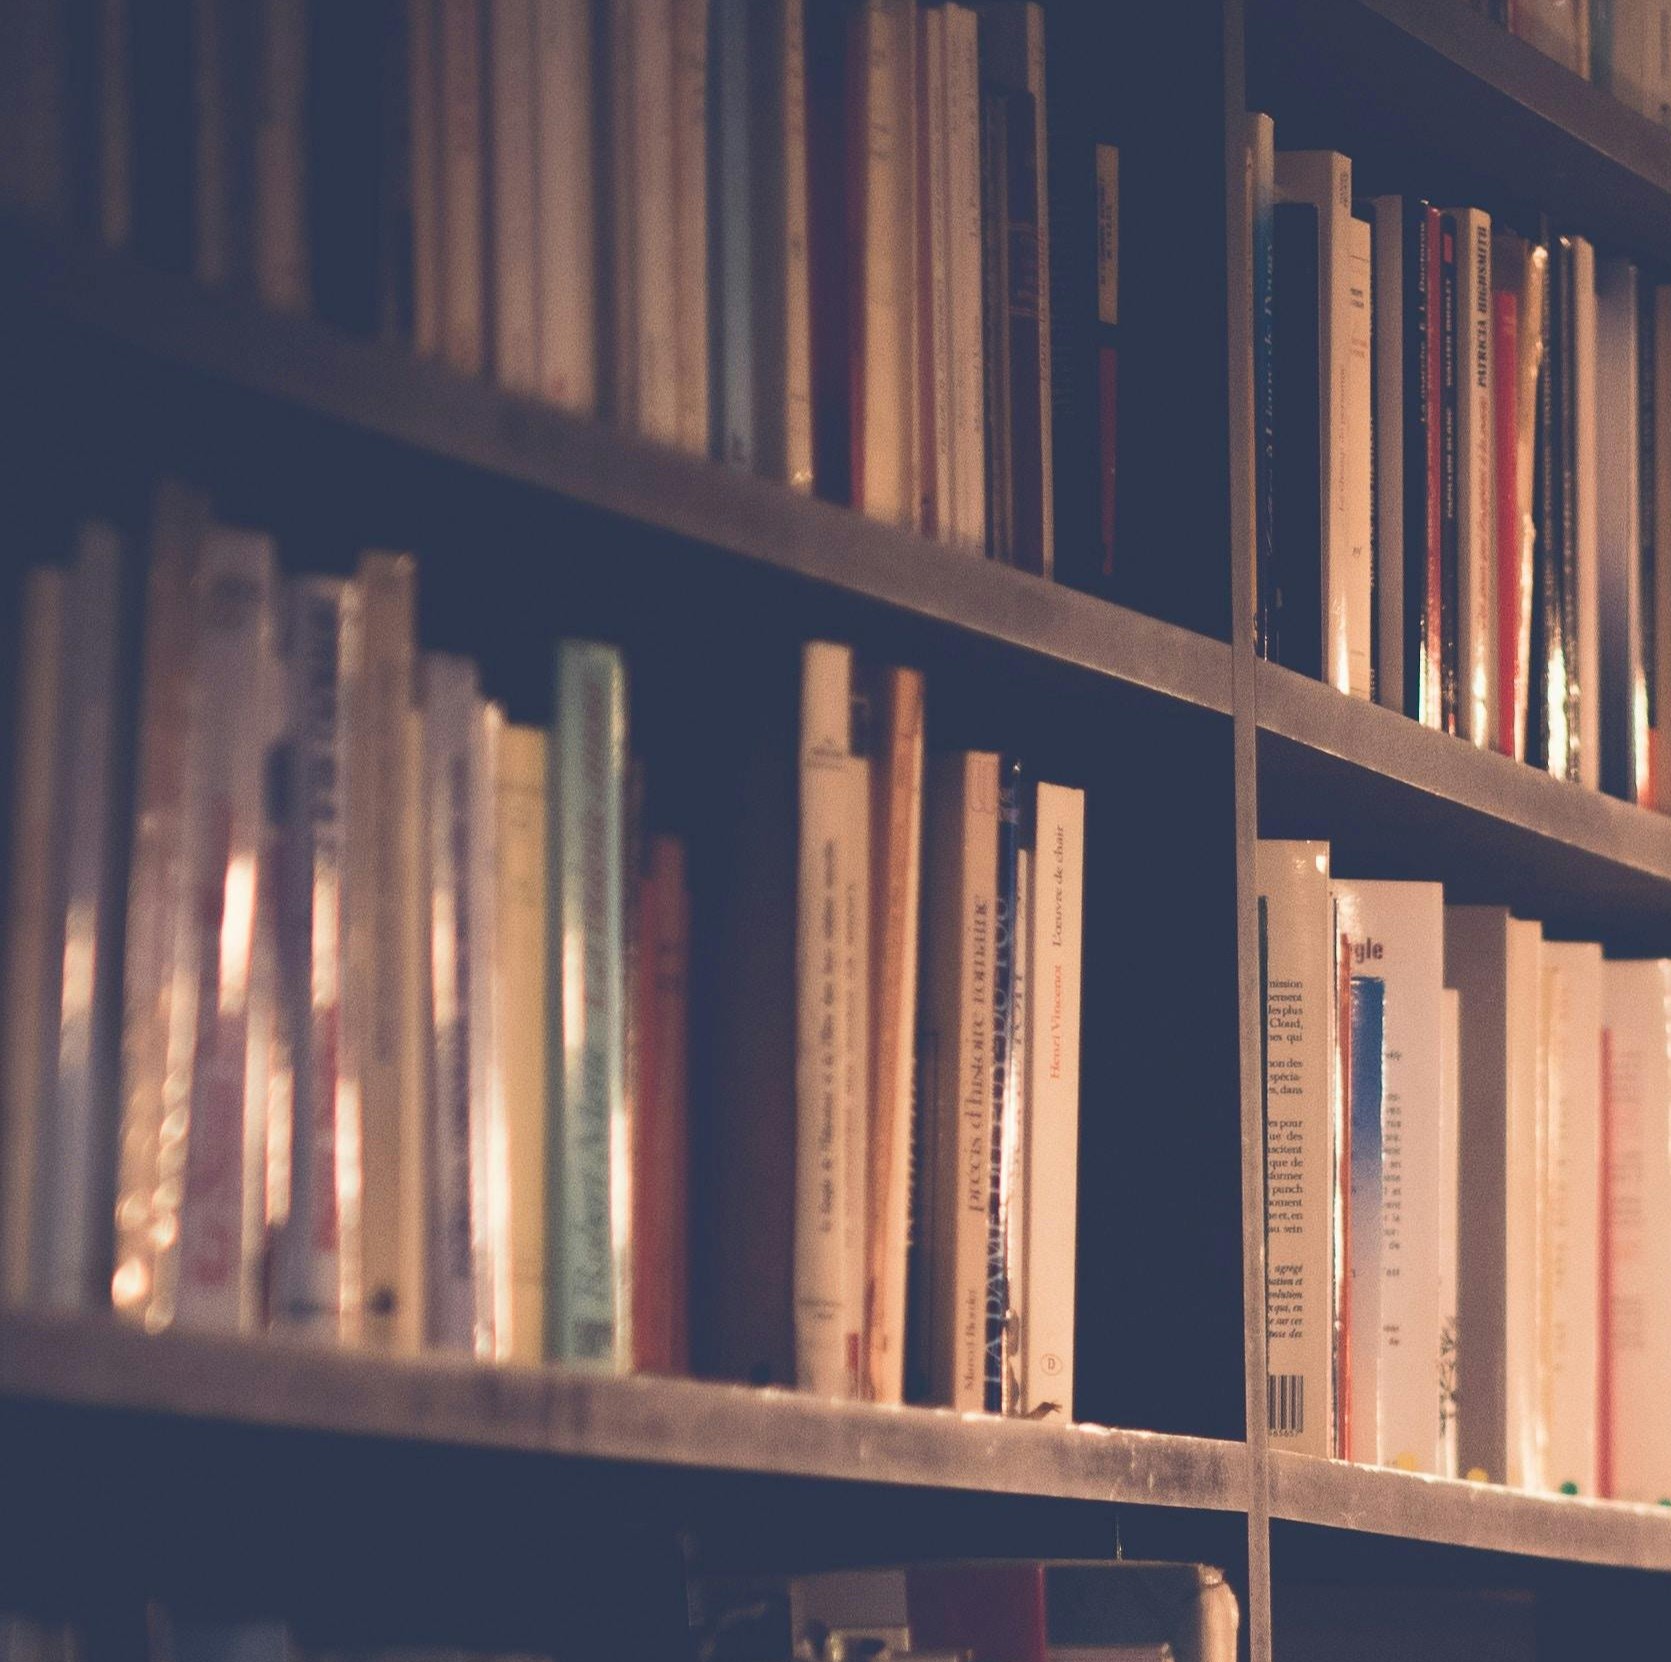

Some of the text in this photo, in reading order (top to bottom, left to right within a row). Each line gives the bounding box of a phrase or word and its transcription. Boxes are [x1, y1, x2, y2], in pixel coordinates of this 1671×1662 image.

[1476, 225, 1487, 314] HIGHSMITH
[1477, 319, 1487, 388] PATRICIA
[1053, 824, 1065, 864] chair
[1052, 867, 1064, 885] de
[968, 895, 988, 1005] romaine
[1050, 964, 1063, 1032] Vincenot
[1282, 1004, 1303, 1017] plus
[1269, 1018, 1304, 1030] Cloud,
[1286, 1034, 1303, 1045] qui
[1049, 1036, 1061, 1080] Henri
[1286, 1058, 1304, 1069] des
[965, 1018, 985, 1131] d'histoire
[1280, 1085, 1304, 1095] dans
[1280, 1120, 1303, 1130] pour
[1286, 1131, 1303, 1141] des
[1269, 1156, 1304, 1170] que de
[965, 1137, 984, 1213] précis
[1272, 1183, 1303, 1196] punch
[1283, 1224, 1303, 1234] sein
[964, 1339, 976, 1392] Marcel
[985, 1336, 1001, 1383] LA
